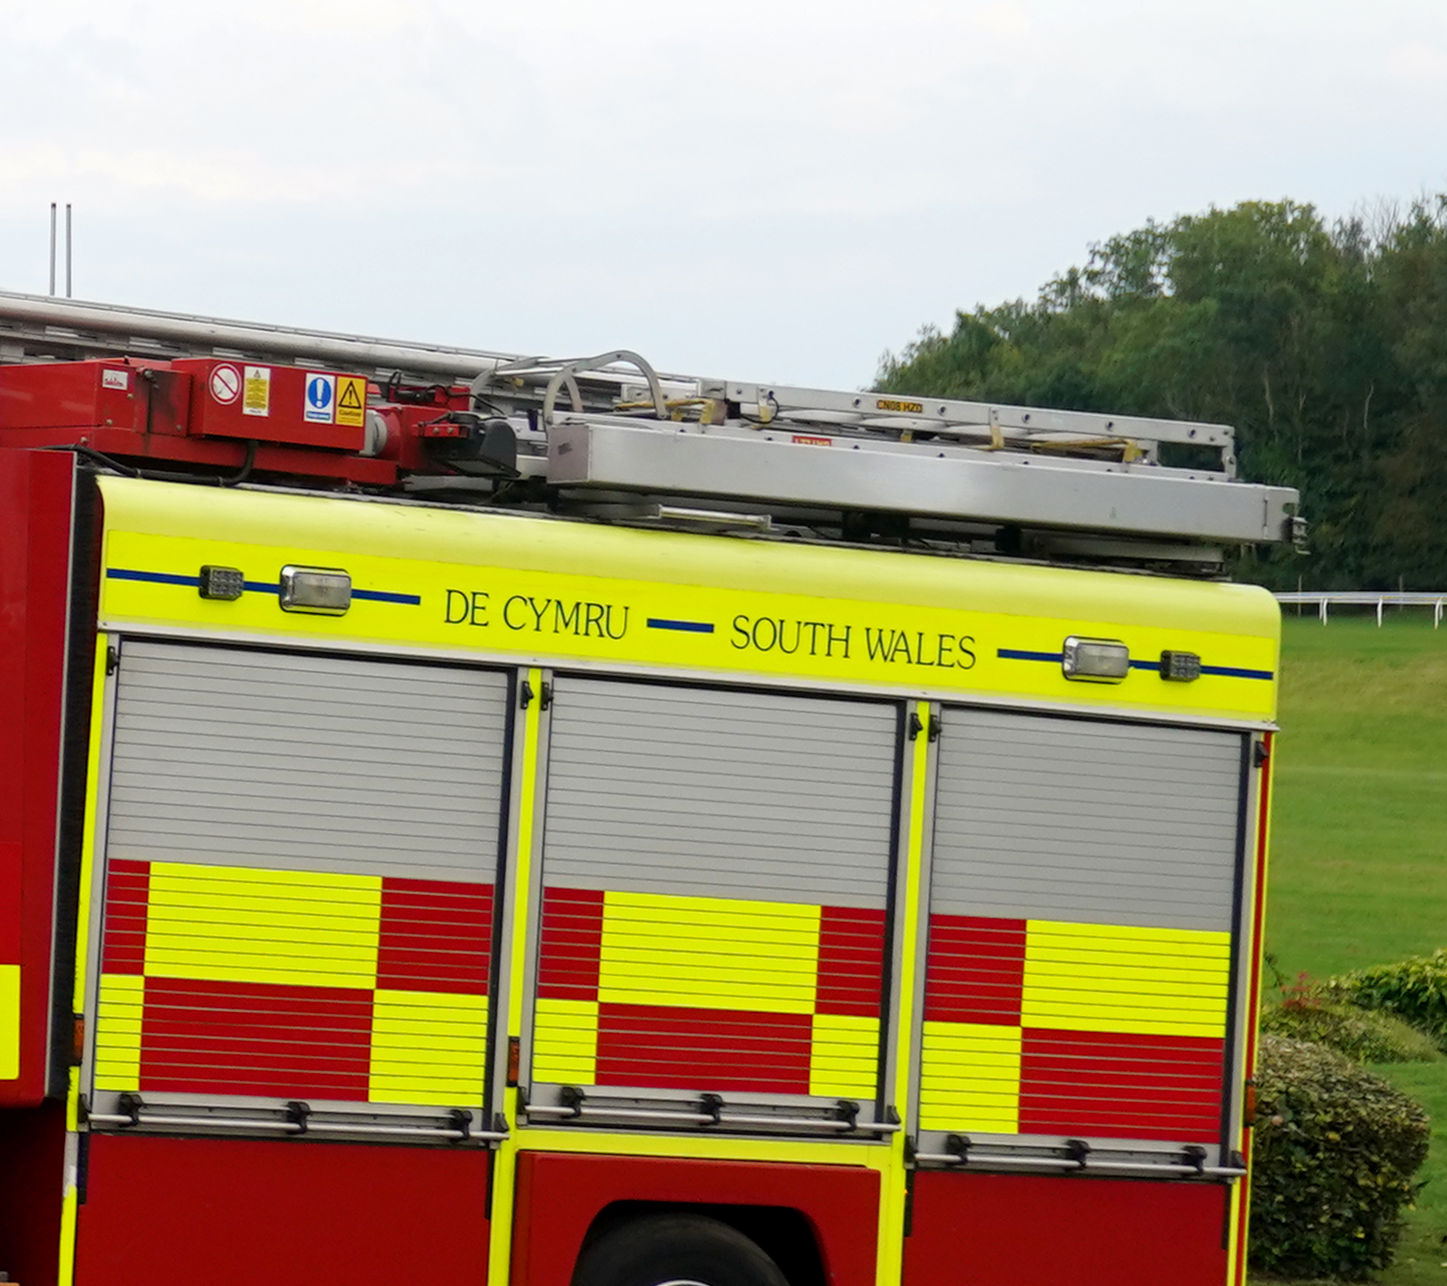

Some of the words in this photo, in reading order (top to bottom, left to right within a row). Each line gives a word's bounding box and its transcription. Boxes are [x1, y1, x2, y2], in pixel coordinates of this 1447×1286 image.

[444, 588, 489, 627] DE
[503, 594, 630, 640] CYMRU
[730, 614, 852, 659] SOUTH
[864, 627, 977, 670] WALES
